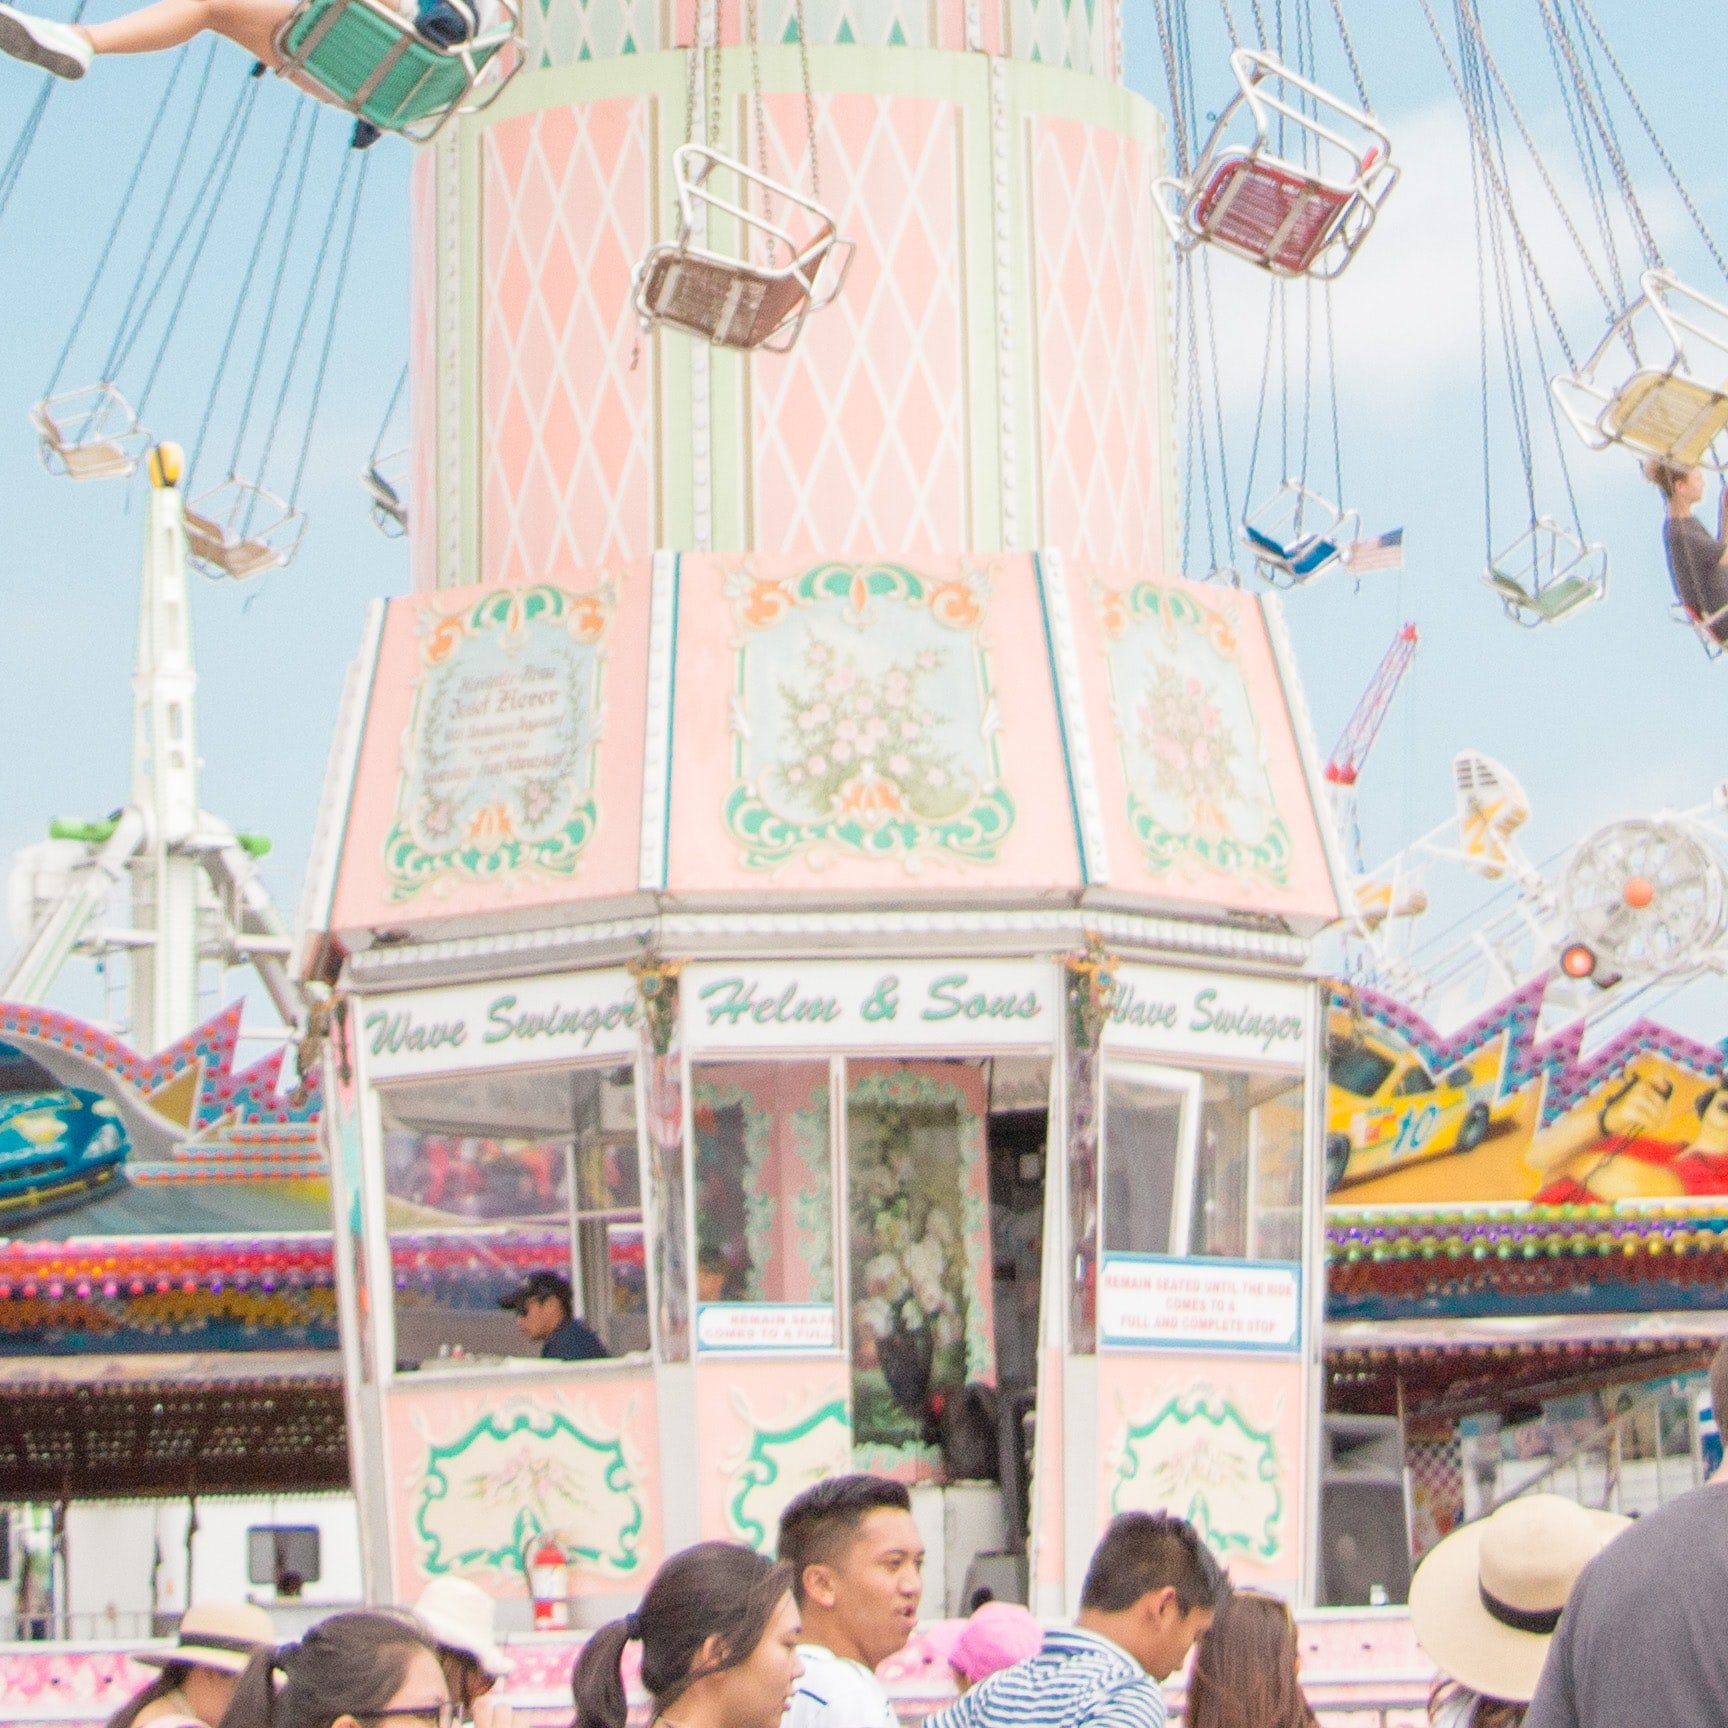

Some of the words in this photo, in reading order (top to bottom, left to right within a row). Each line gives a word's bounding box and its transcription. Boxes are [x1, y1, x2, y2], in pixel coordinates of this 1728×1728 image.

[698, 977, 841, 1025] Helm
[860, 974, 900, 1024] &
[920, 973, 1042, 1021] Sons
[1188, 987, 1304, 1053] Swinger
[365, 1008, 469, 1056] Wave
[481, 995, 639, 1049] Swinger
[1390, 1103, 1439, 1156] 10
[1105, 1274, 1152, 1290] REMAIN
[1156, 1277, 1201, 1293] SEATED
[1205, 1278, 1239, 1295] UNTIL
[1241, 1280, 1264, 1296] THE
[1166, 1296, 1206, 1312] COMES
[1211, 1297, 1225, 1312] TO
[1228, 1298, 1236, 1313] A
[1120, 1313, 1150, 1330] FULL
[1153, 1315, 1178, 1330] AND
[1182, 1315, 1244, 1332] COMPLETE
[1246, 1318, 1278, 1333] STOP
